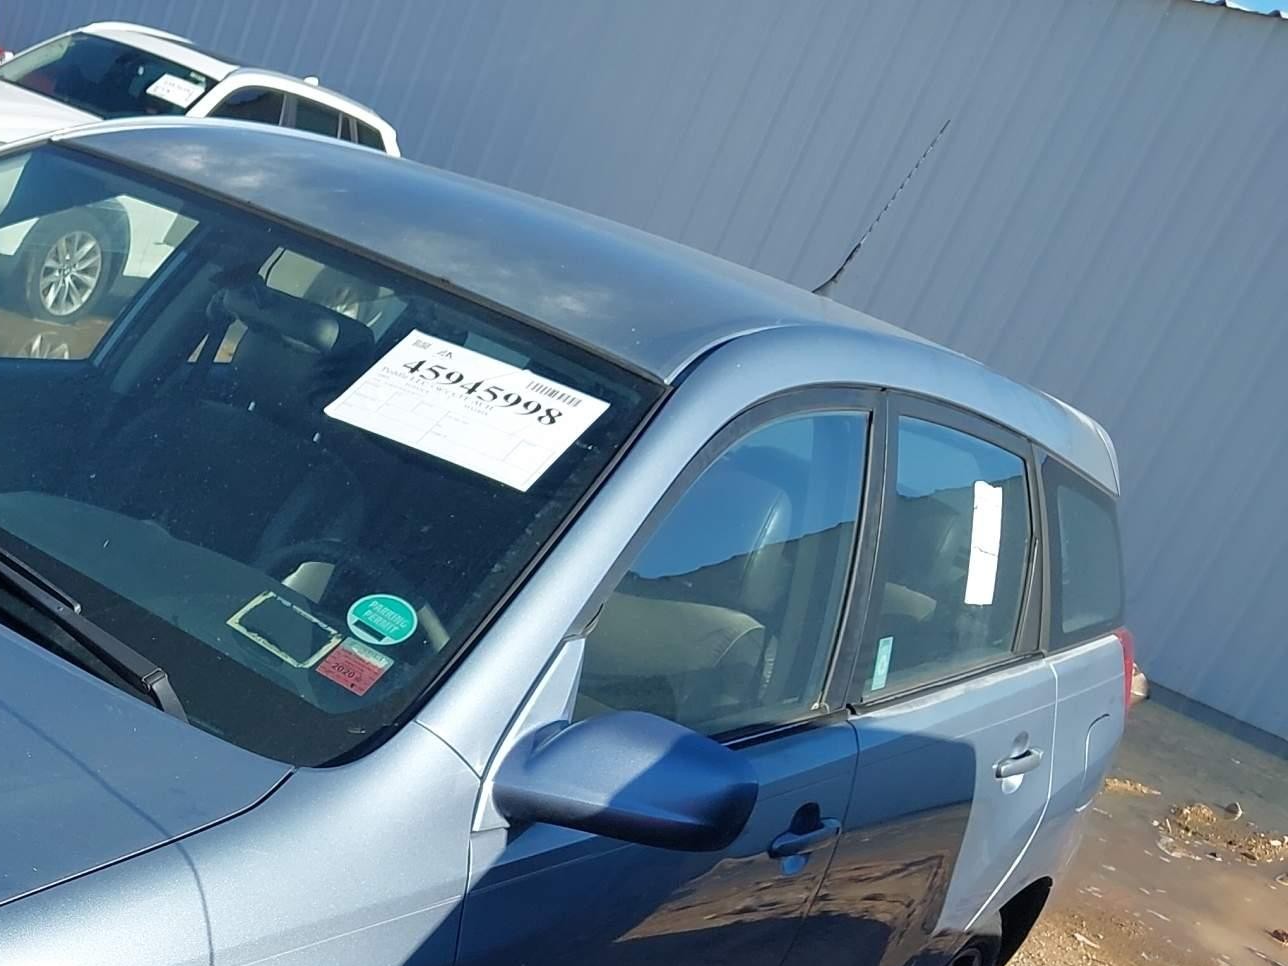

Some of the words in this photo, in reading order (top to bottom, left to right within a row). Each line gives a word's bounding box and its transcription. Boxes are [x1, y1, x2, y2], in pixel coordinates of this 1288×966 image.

[402, 358, 563, 426] 45945998
[363, 609, 399, 634] PERMIT
[368, 600, 408, 628] PARKING
